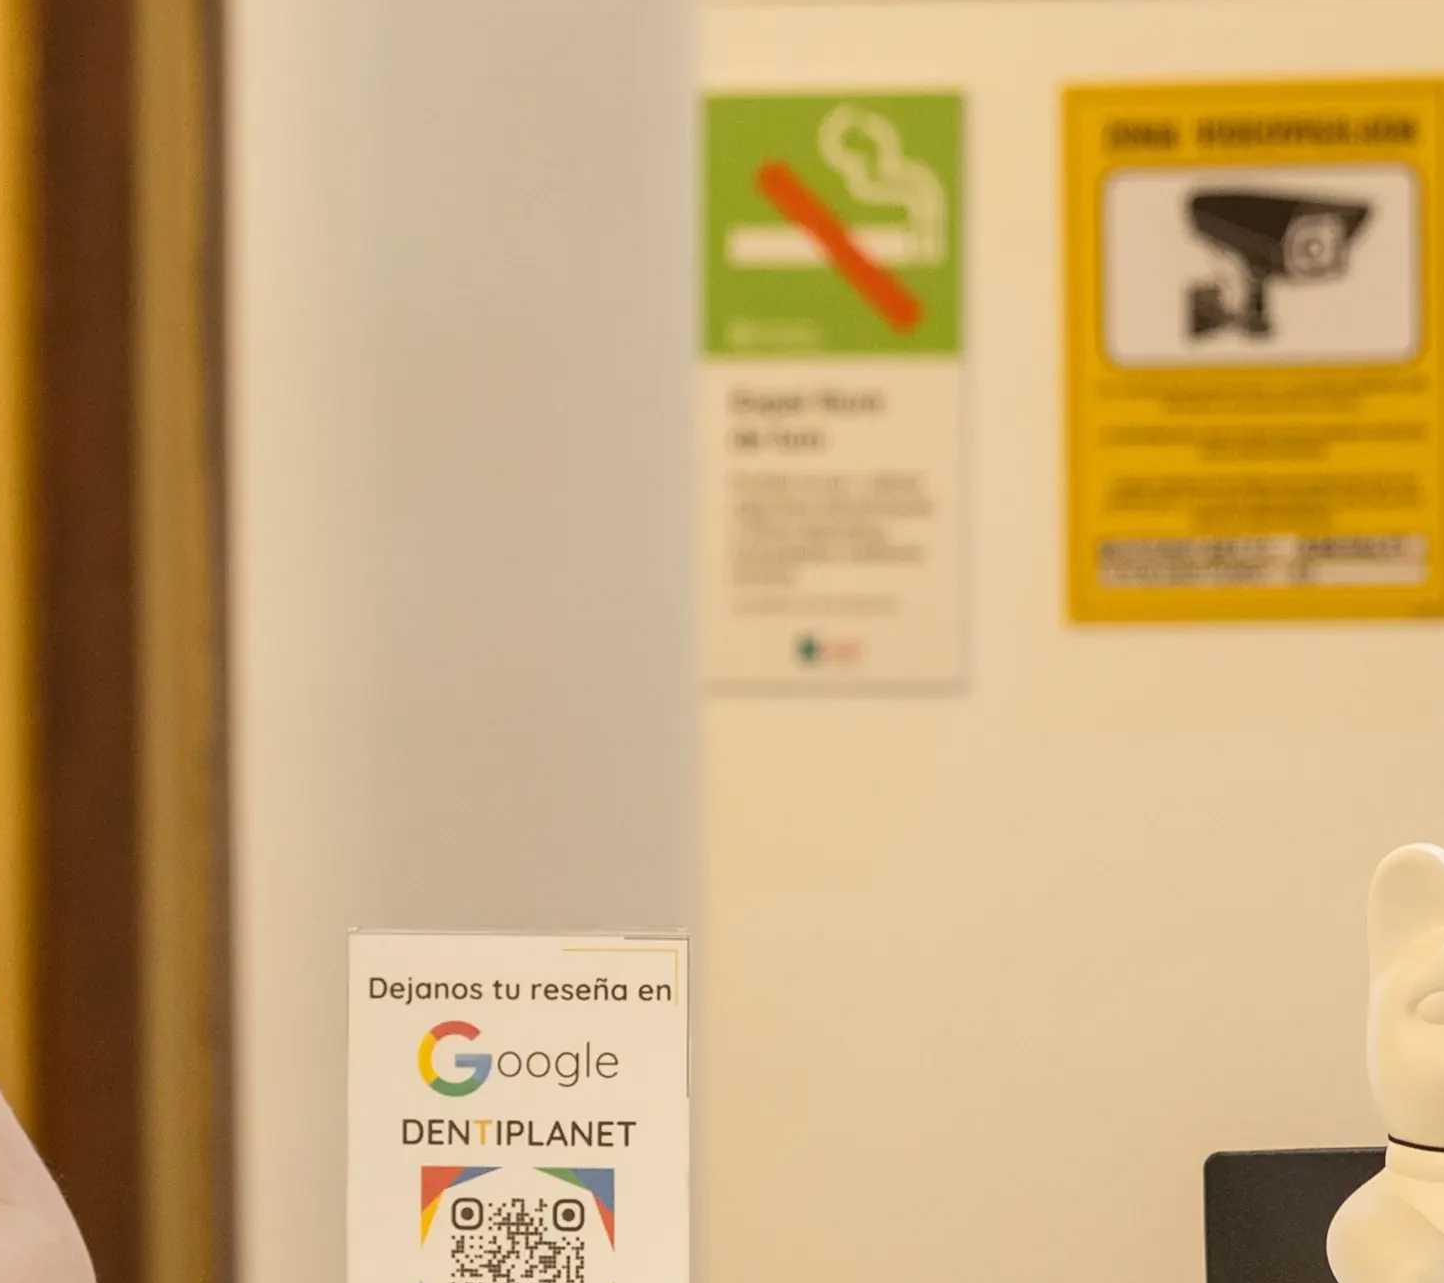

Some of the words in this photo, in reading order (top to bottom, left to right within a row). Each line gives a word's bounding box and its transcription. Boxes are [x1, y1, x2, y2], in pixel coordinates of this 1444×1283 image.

[368, 976, 484, 1005] Dejanos
[492, 979, 521, 1001] tu
[530, 977, 628, 1002] reseña
[637, 983, 672, 1002] en
[417, 1020, 620, 1098] Google
[401, 1118, 638, 1148] DENTIPLANET
